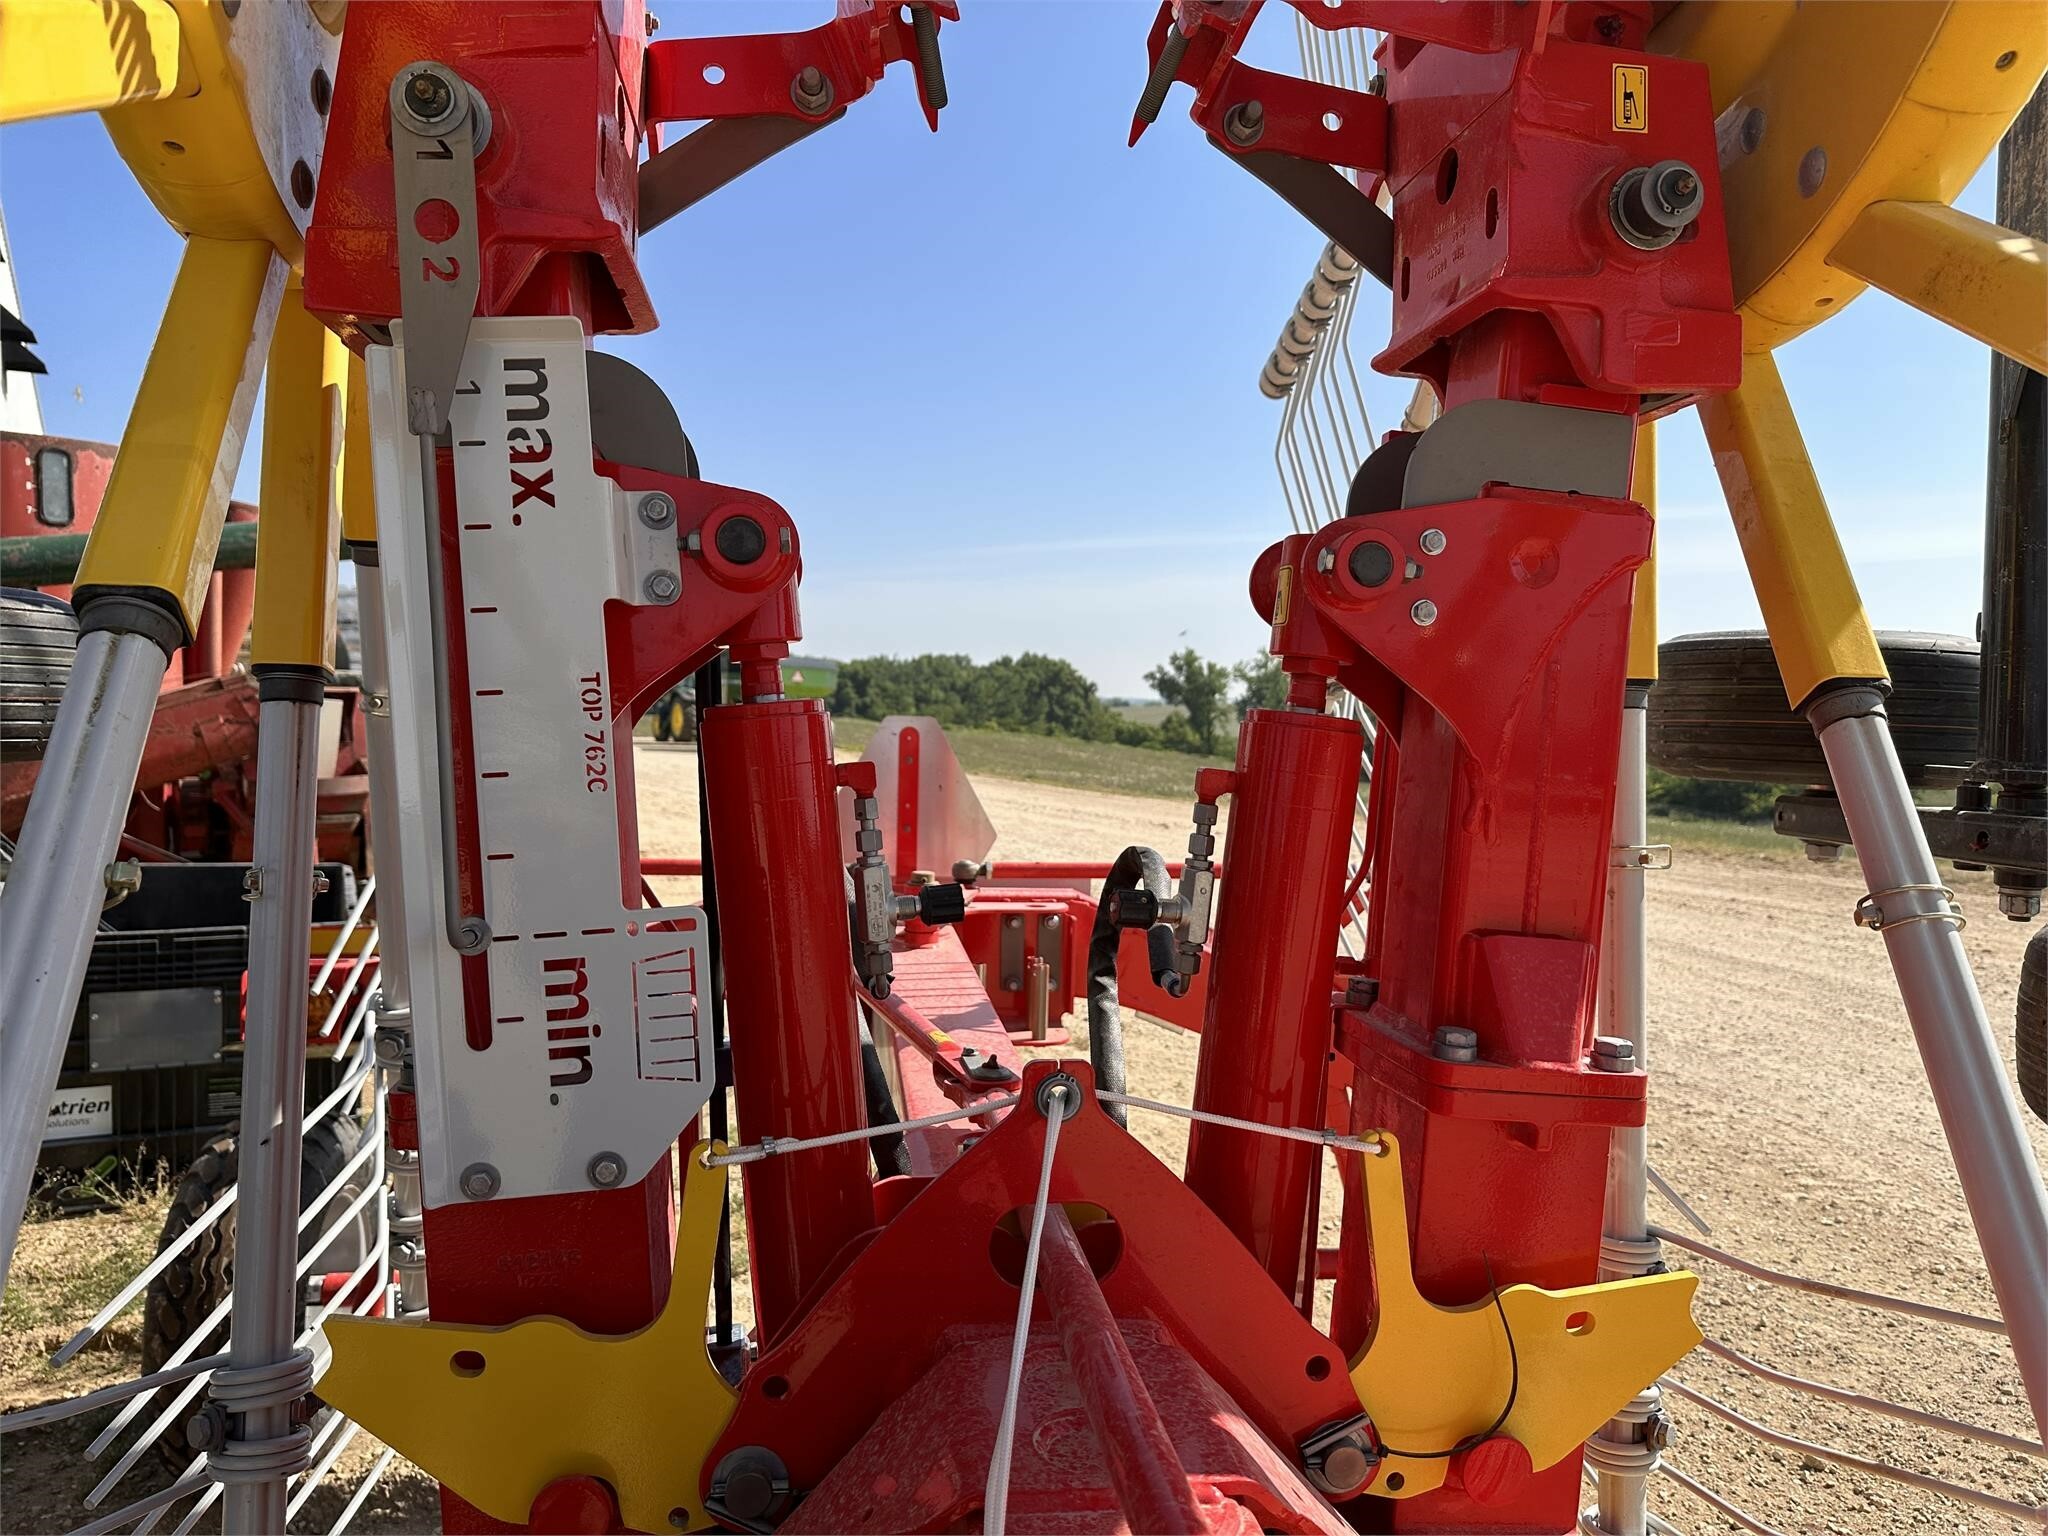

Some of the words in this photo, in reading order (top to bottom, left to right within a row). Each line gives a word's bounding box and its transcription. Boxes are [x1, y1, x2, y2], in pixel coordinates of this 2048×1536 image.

[416, 139, 454, 160] 1
[422, 256, 461, 282] 2
[455, 380, 481, 395] 1
[503, 357, 556, 527] max.
[580, 672, 603, 722] TOP
[584, 730, 608, 793] 762C
[543, 957, 602, 1106] min.
